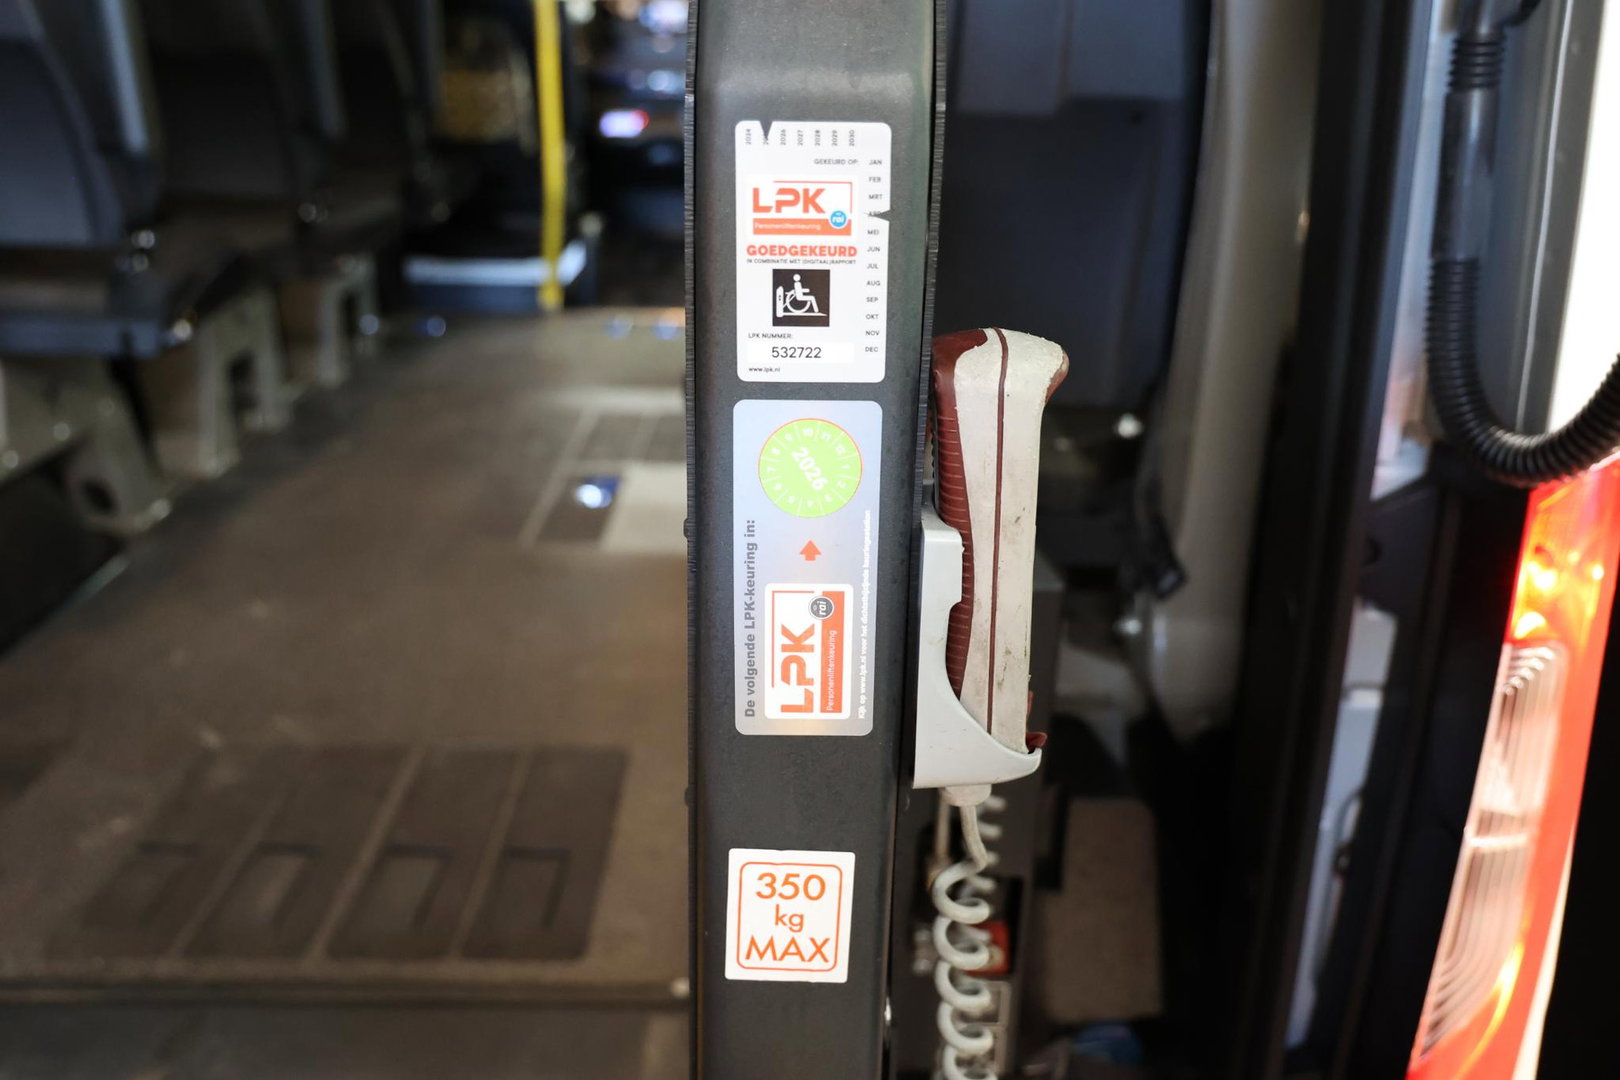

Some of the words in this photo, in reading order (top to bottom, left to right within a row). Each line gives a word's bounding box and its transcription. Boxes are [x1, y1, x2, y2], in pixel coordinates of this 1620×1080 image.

[752, 187, 826, 214] LPK
[746, 244, 857, 257] GOEDGEKEURD
[771, 346, 822, 359] 532722
[791, 446, 829, 491] 2026
[744, 520, 755, 537] in:
[744, 542, 758, 629] LPK-keuring
[817, 600, 827, 616] rai
[744, 633, 758, 696] volgende
[780, 623, 815, 713] LPK
[826, 629, 837, 712] Personenliftenkeuring
[859, 656, 868, 693] www.lpk.nl
[745, 699, 755, 717] De
[859, 694, 867, 704] op
[756, 872, 826, 901] 350
[774, 904, 804, 933] kg
[745, 935, 830, 963] MAX
